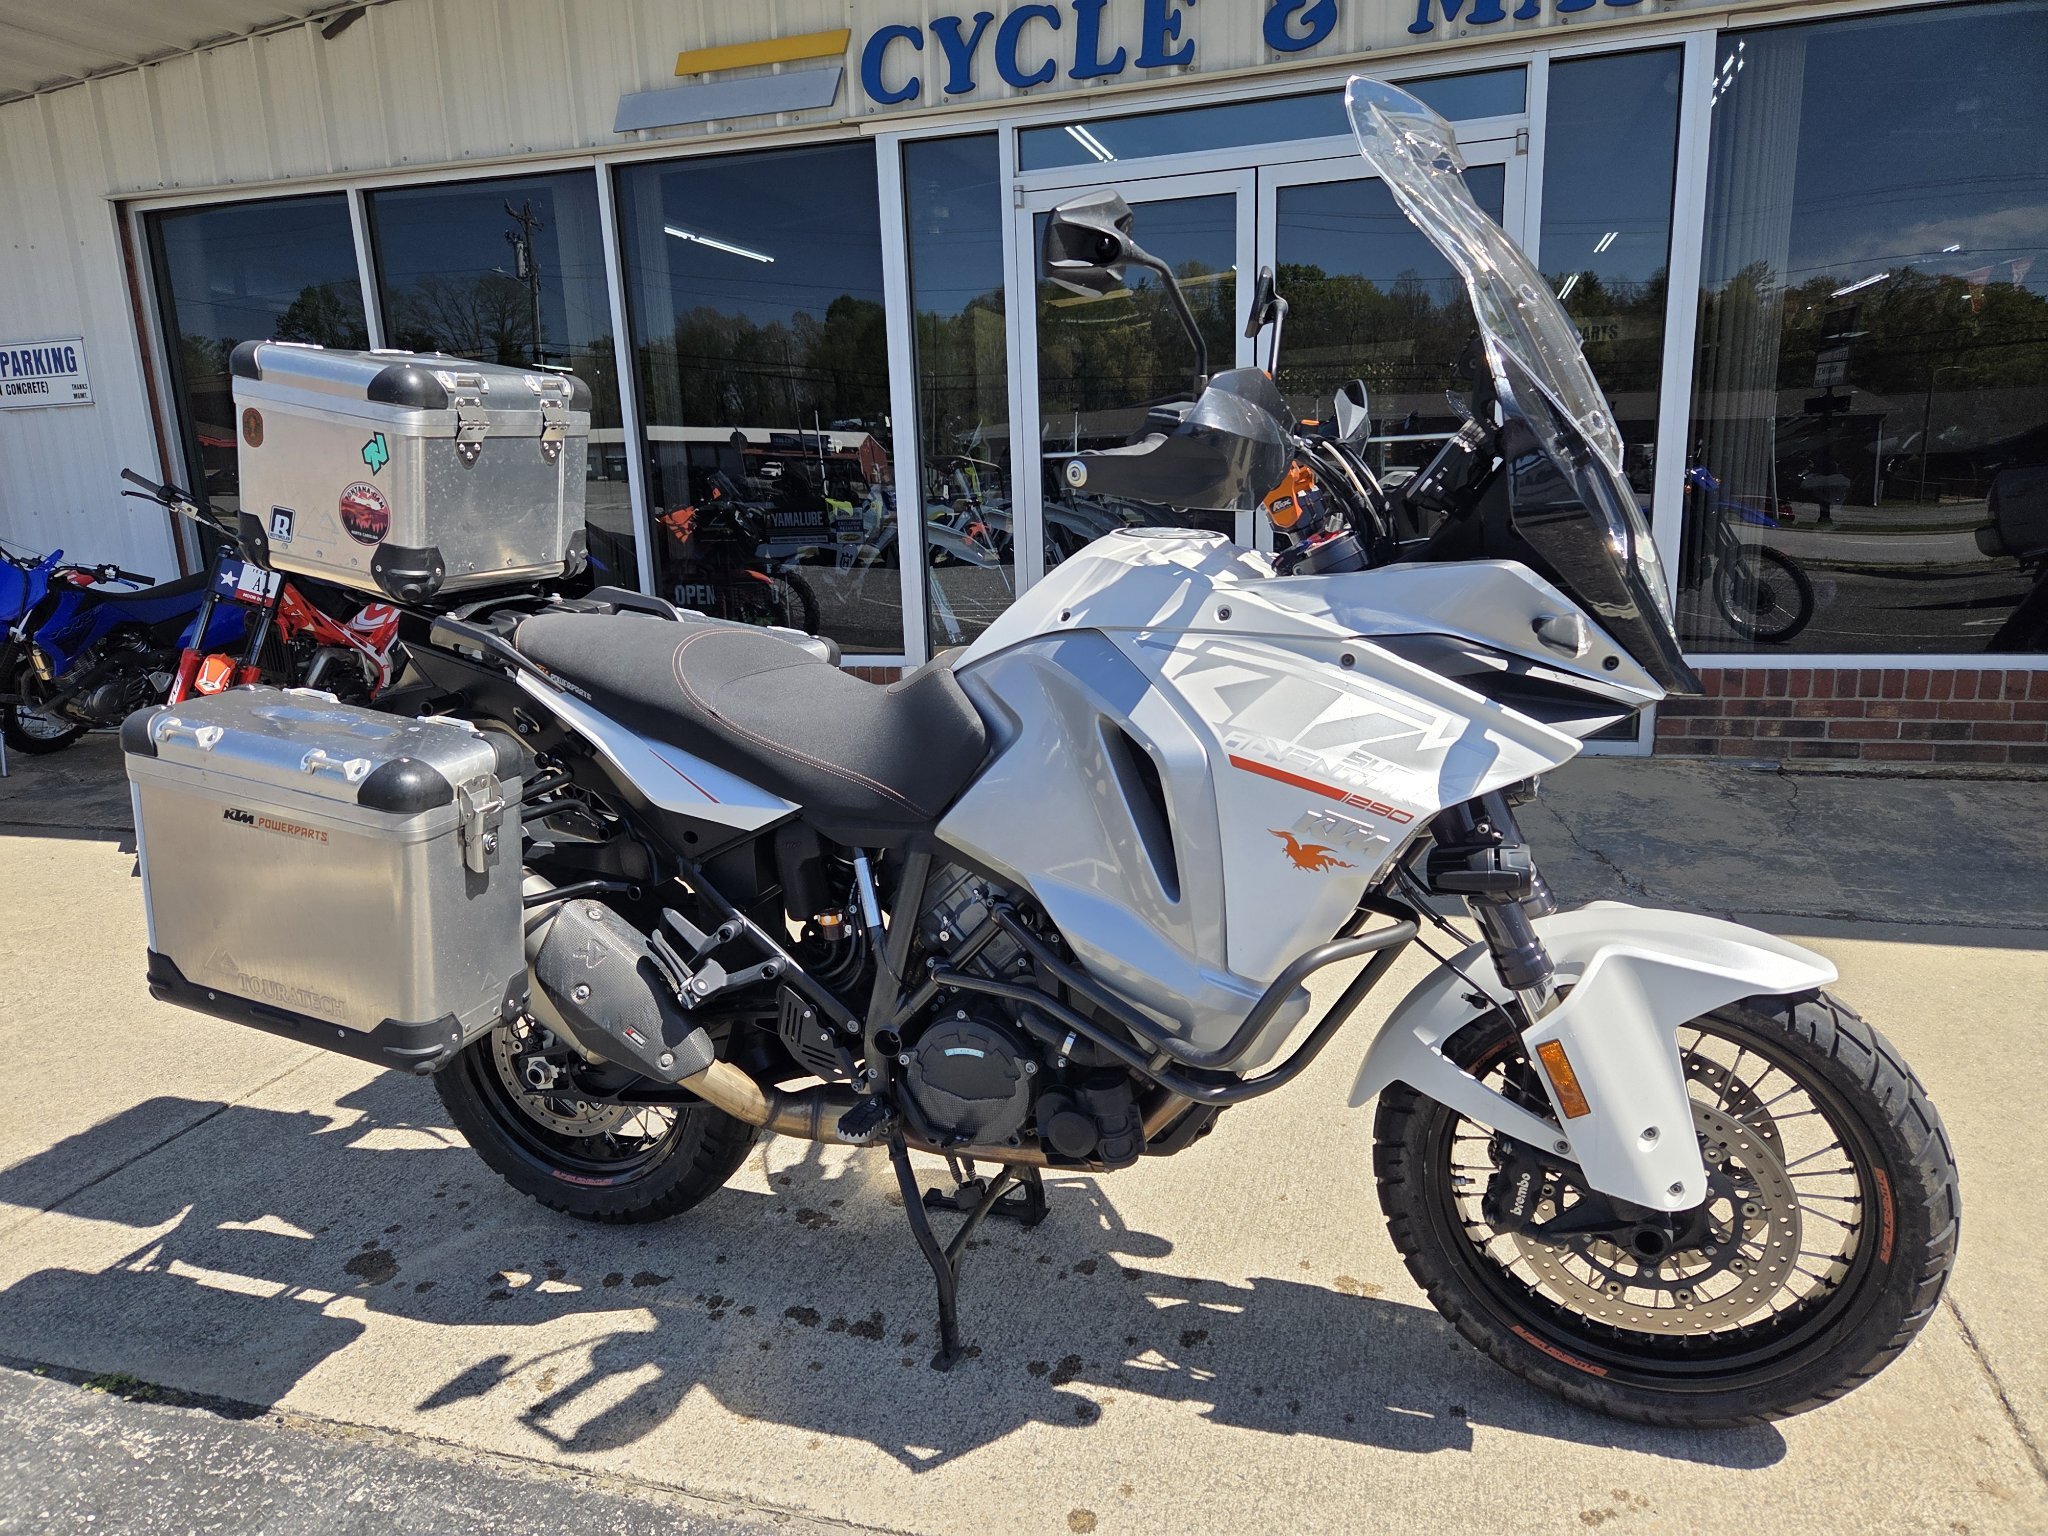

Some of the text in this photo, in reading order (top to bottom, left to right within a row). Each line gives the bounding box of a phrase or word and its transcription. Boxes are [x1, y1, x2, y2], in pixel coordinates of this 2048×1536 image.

[861, 0, 1196, 105] CYCLE
[0, 346, 78, 378] PARKING
[5, 381, 50, 396] CONCRETE)
[771, 511, 824, 527] YAMALUBE
[674, 584, 716, 605] OPEN
[1225, 731, 1422, 807] ADVENT
[223, 807, 329, 842] KTM POWERPARTS
[1339, 791, 1415, 825] 1290
[239, 973, 347, 1020] TOURATECH
[1510, 1172, 1531, 1216] brembo
